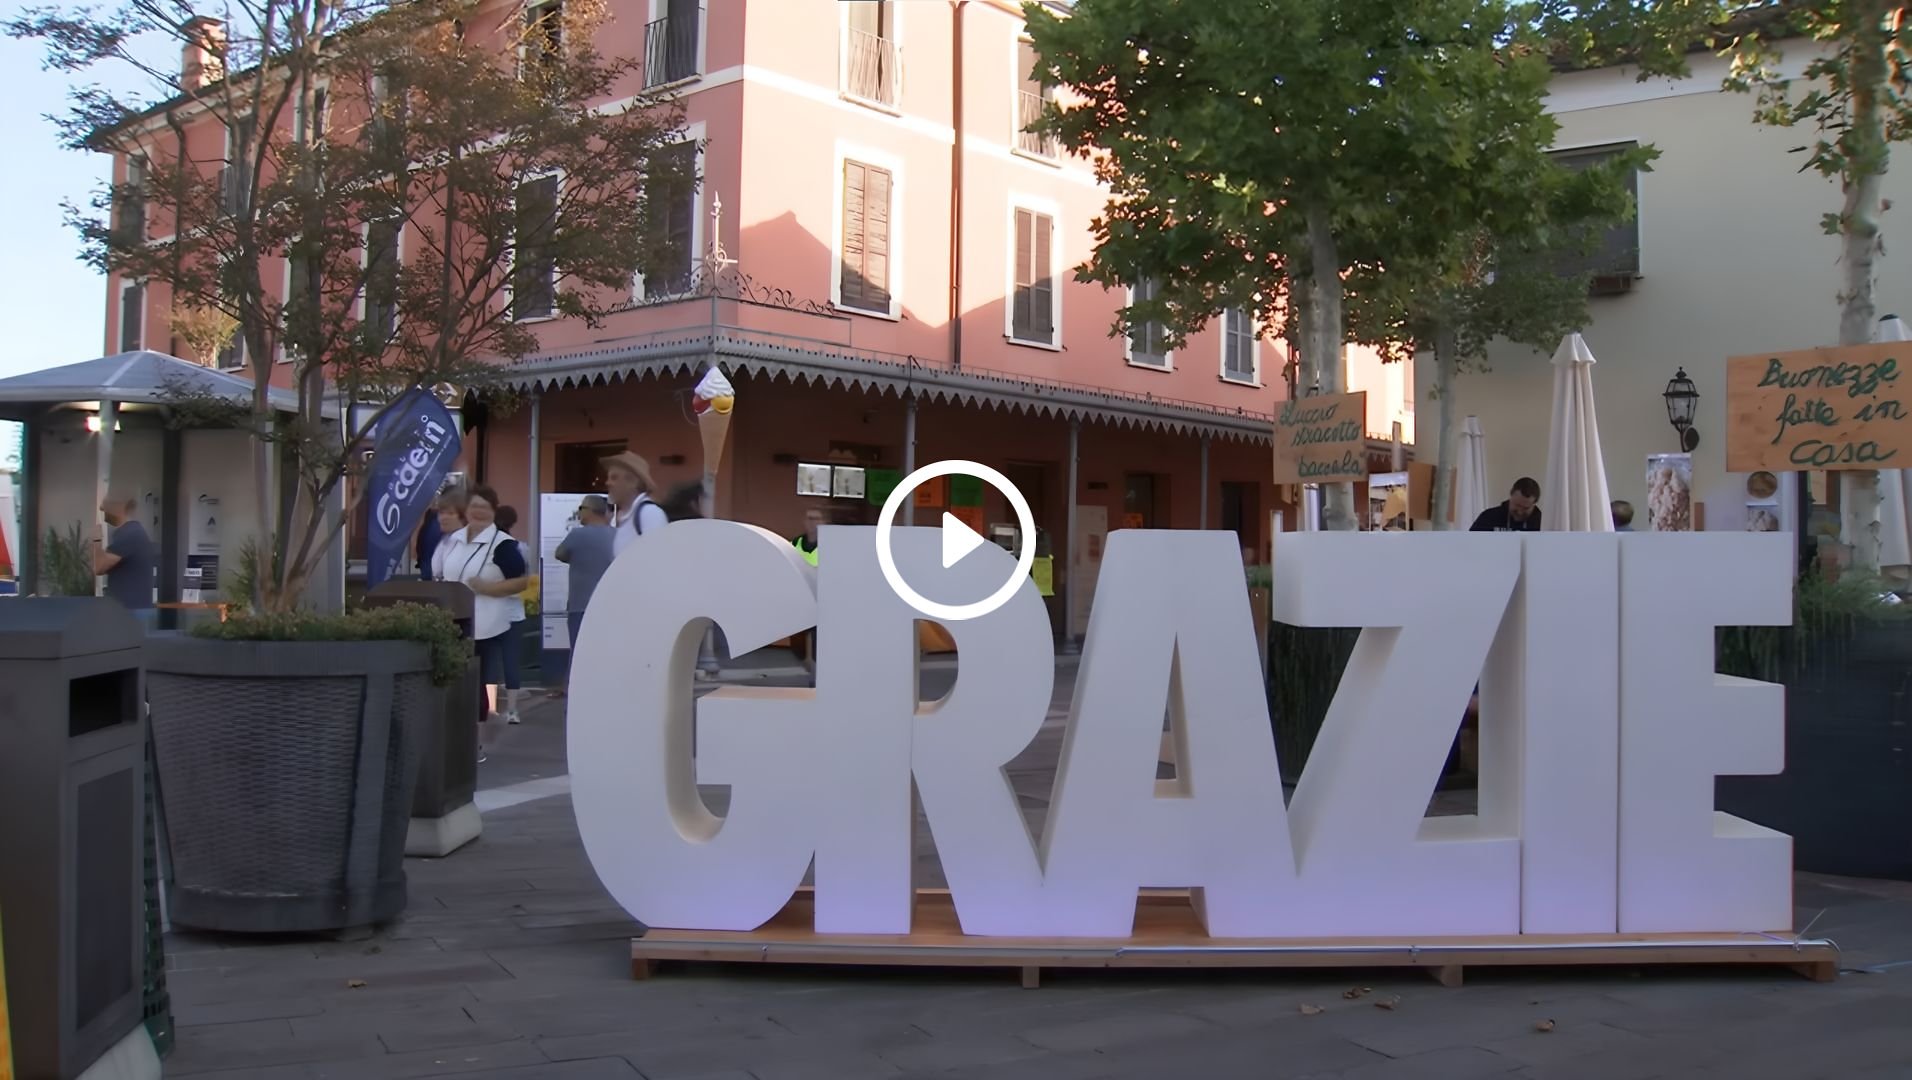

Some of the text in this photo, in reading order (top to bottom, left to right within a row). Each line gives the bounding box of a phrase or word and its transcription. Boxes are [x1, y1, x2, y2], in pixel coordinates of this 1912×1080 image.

[1771, 393, 1908, 445] fatte in
[567, 520, 1794, 937] GRAZIE
